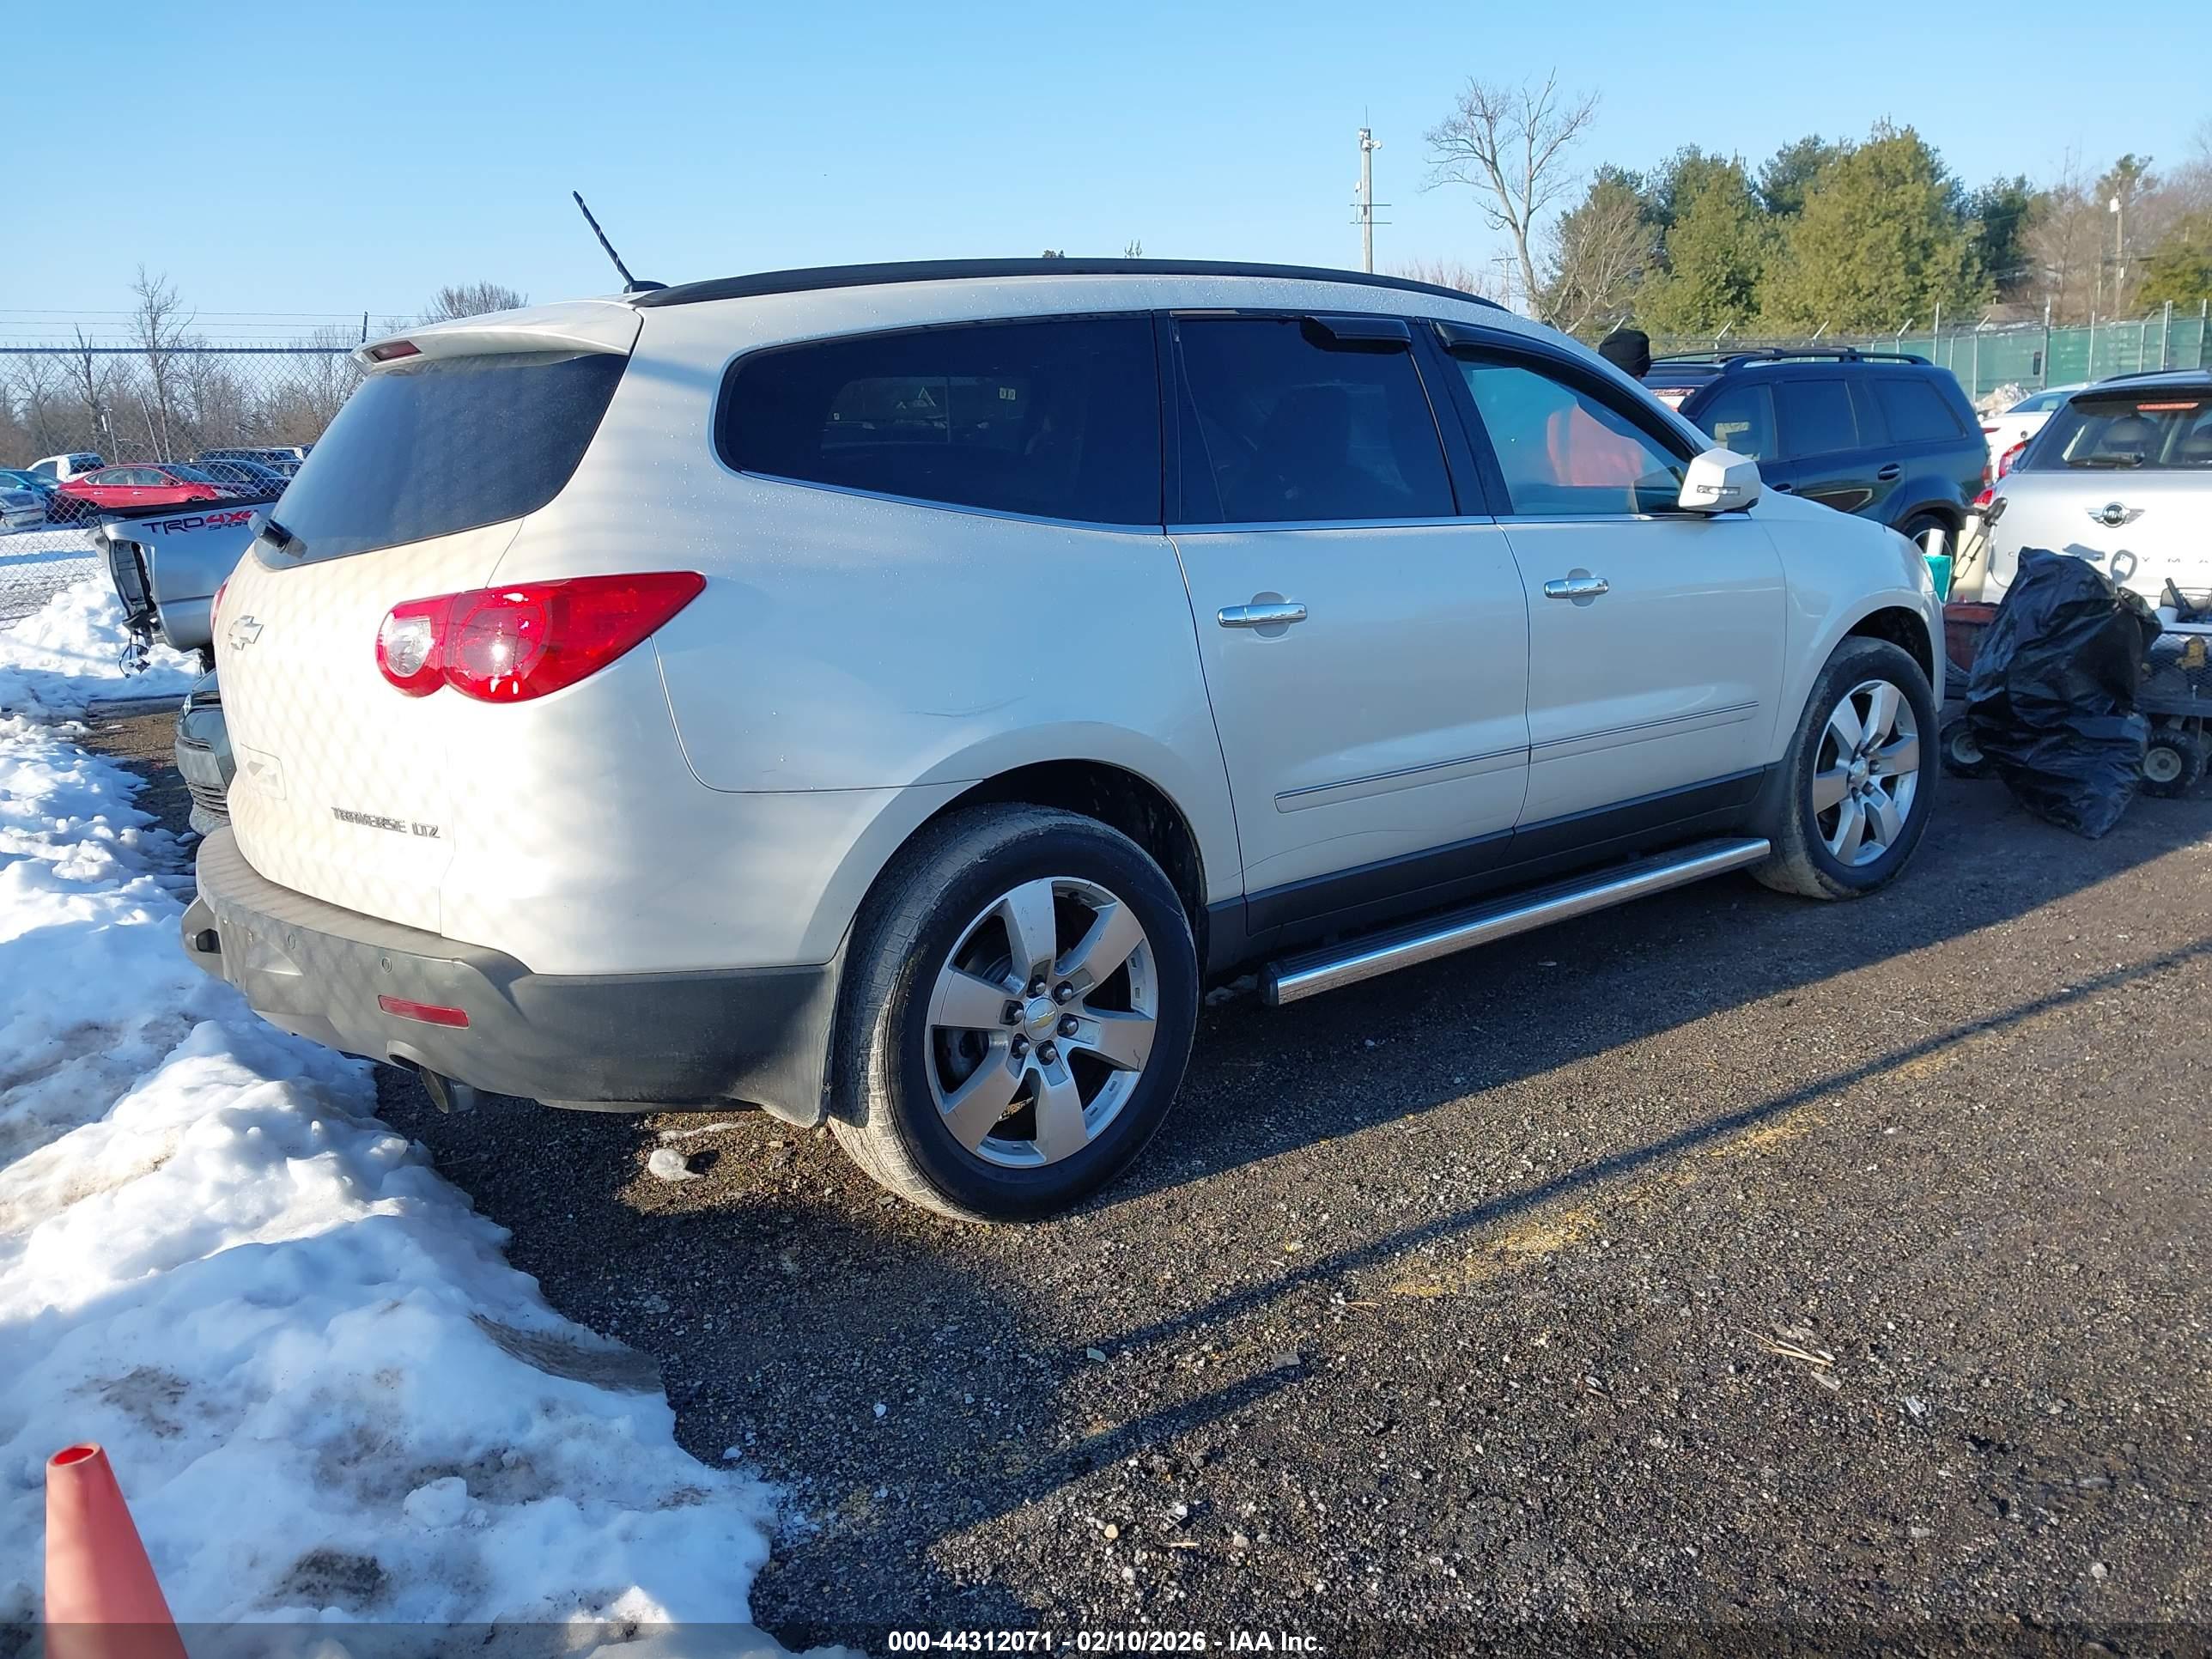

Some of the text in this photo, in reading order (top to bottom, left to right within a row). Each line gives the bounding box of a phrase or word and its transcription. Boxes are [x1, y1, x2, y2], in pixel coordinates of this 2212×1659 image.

[142, 517, 204, 535] TRD
[331, 806, 441, 838] TRAVERSE LTZ
